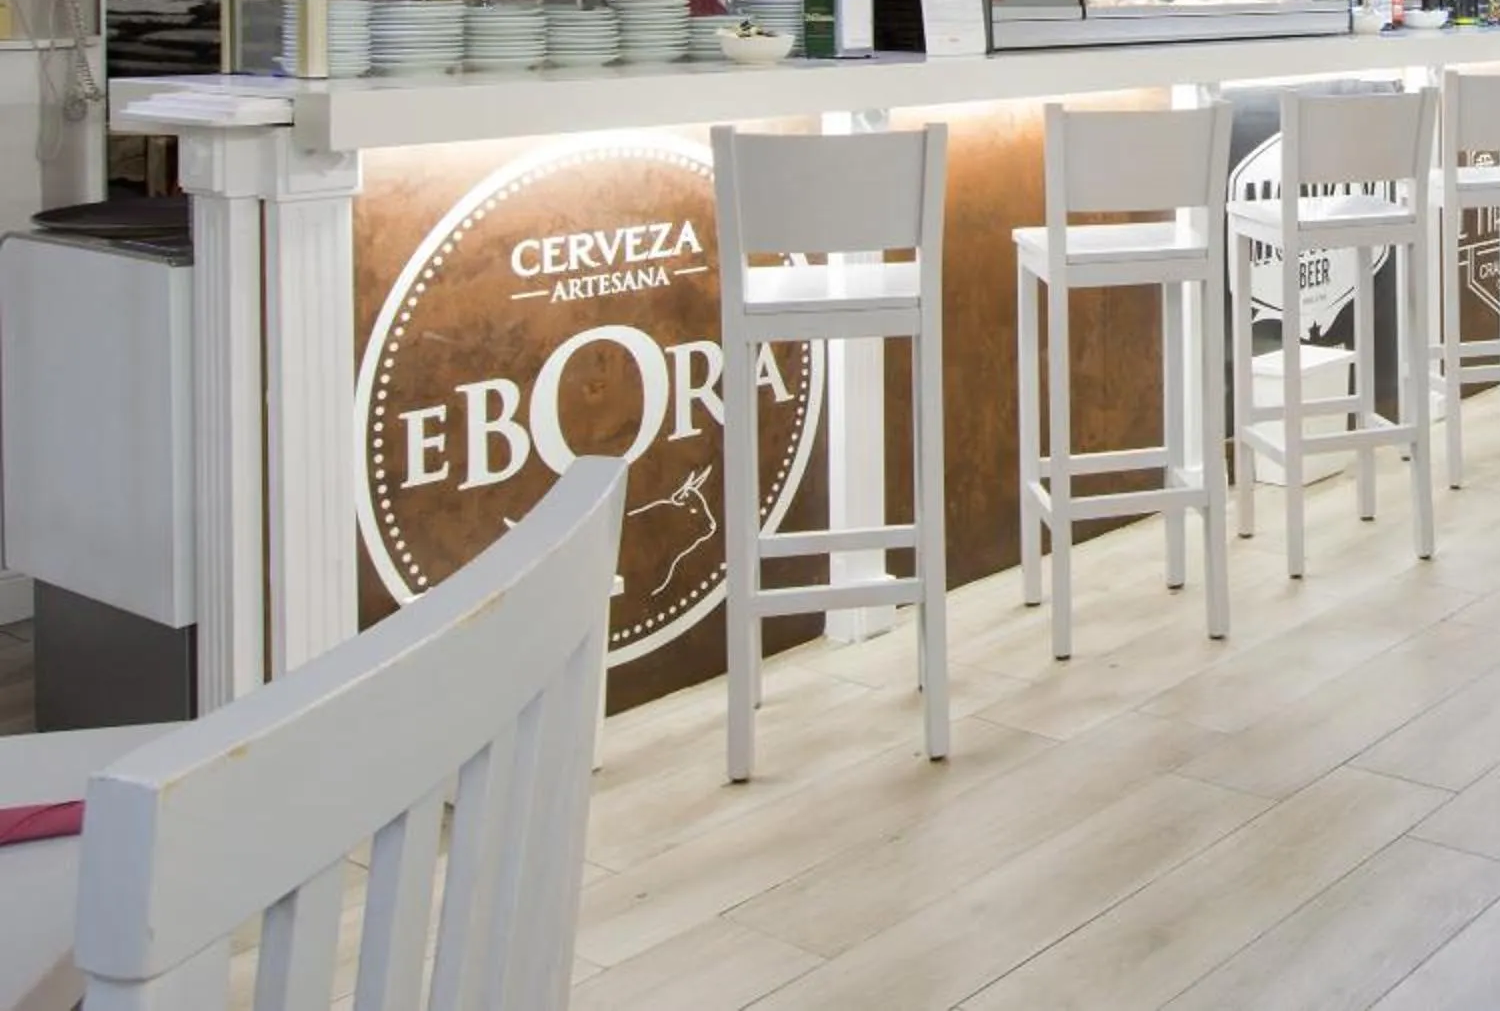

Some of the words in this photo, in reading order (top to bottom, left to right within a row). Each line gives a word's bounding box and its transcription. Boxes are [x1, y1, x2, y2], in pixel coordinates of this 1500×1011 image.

[511, 220, 703, 278] CERVEZA
[550, 266, 671, 303] ARTESANA
[1299, 257, 1331, 290] BEER
[398, 324, 794, 491] EBORA
